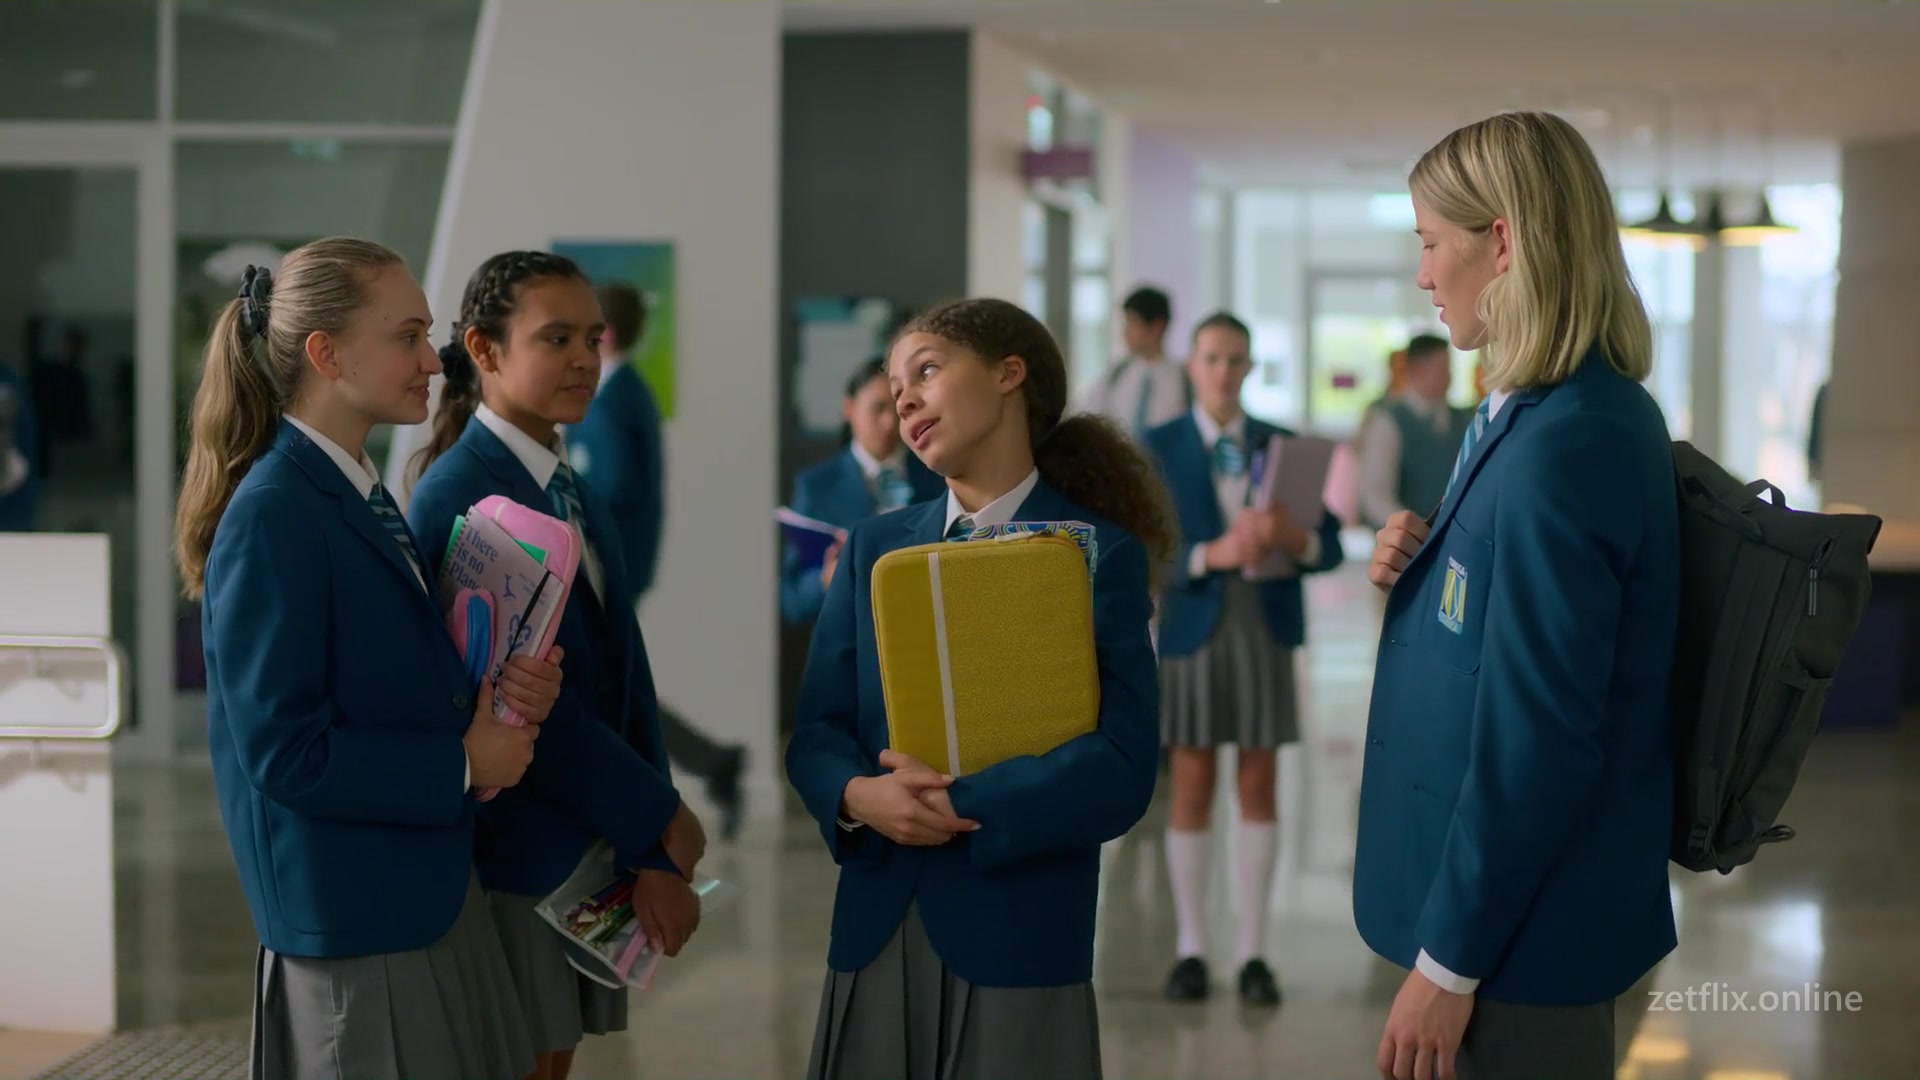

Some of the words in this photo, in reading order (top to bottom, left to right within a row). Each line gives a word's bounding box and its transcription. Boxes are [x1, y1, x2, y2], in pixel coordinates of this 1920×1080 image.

[456, 543, 469, 561] is
[468, 555, 485, 575] no
[466, 526, 498, 562] There
